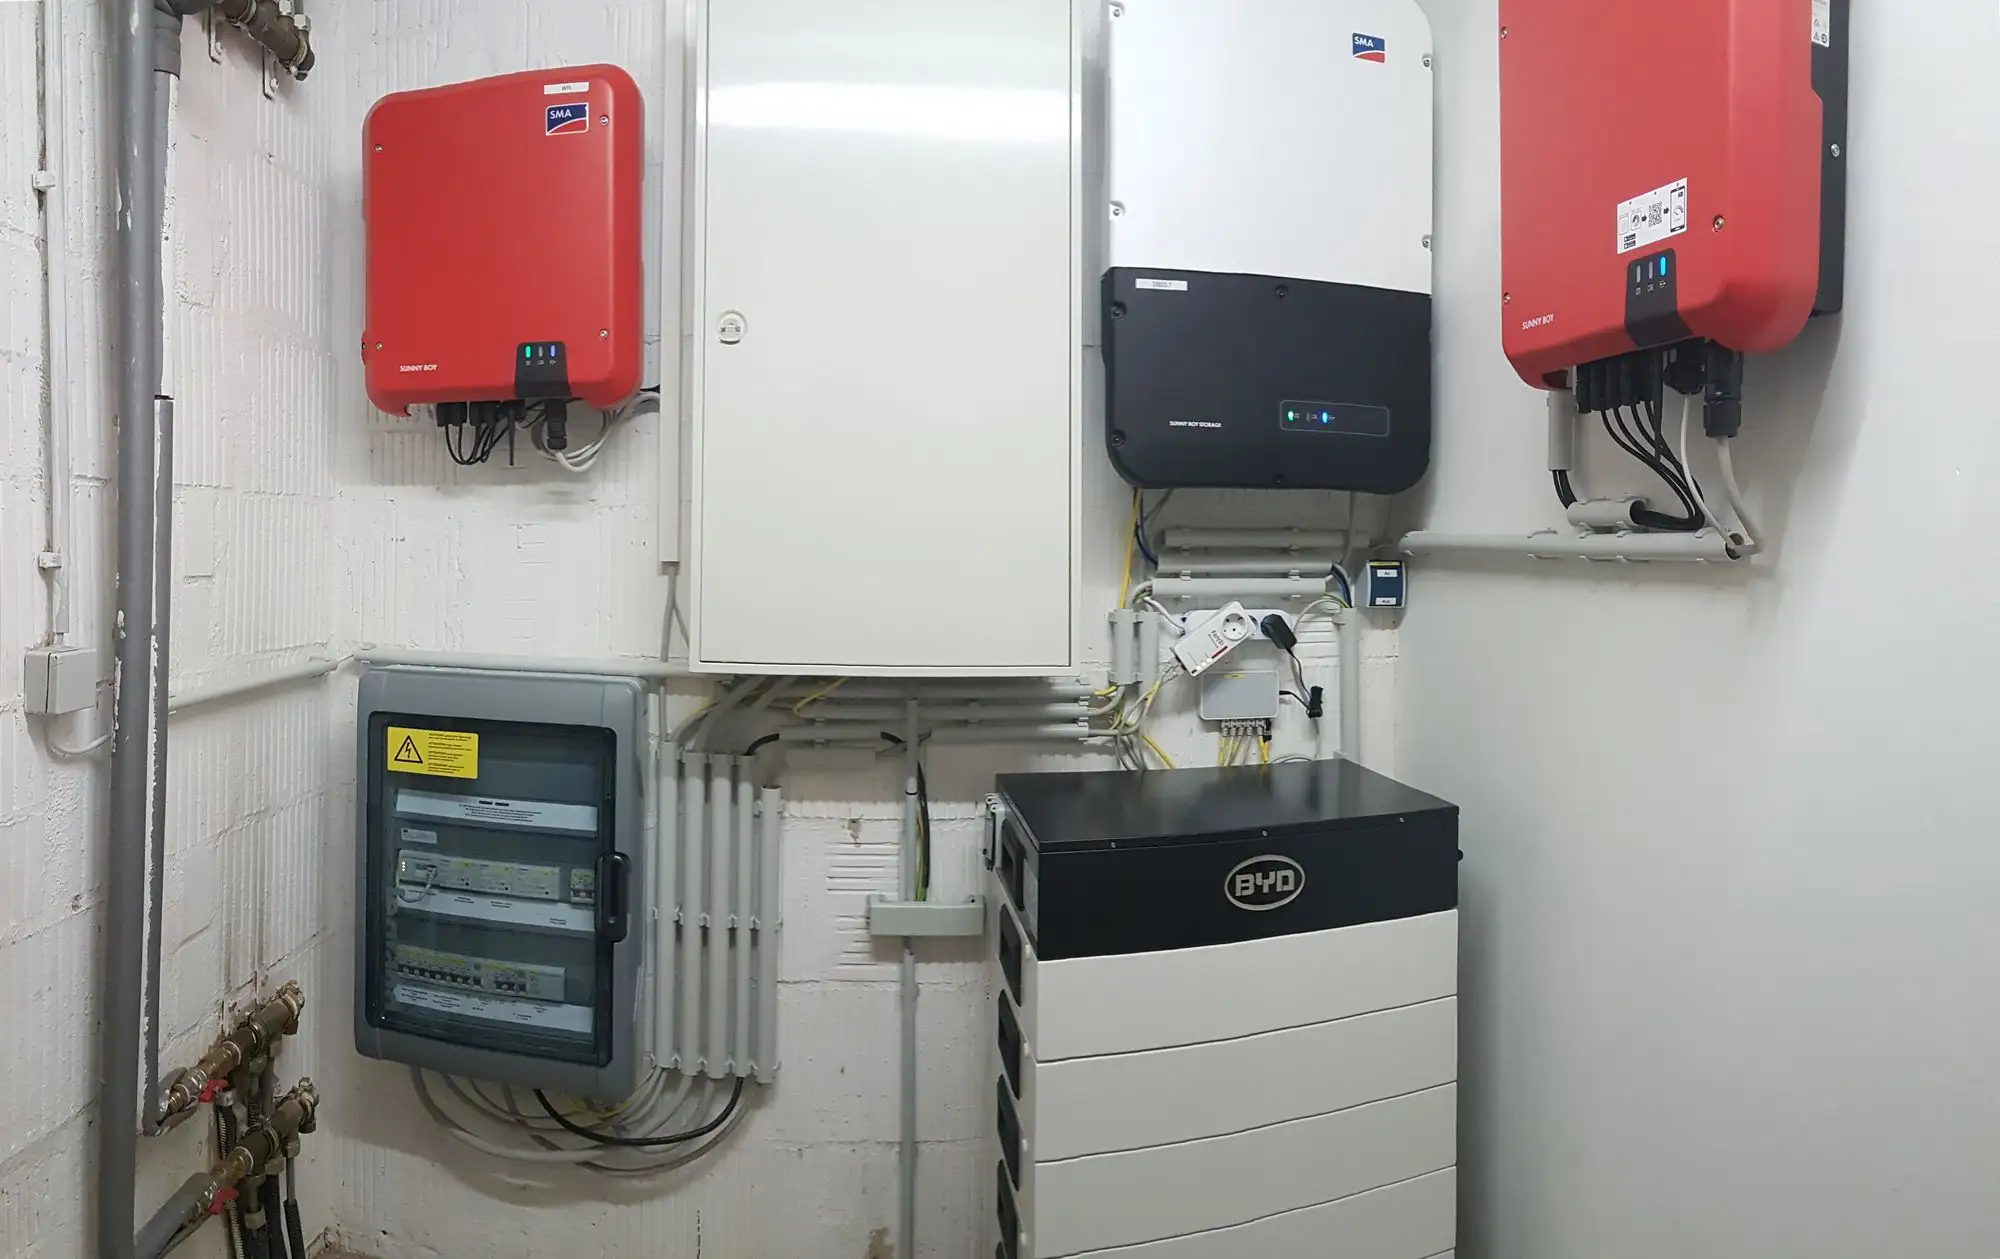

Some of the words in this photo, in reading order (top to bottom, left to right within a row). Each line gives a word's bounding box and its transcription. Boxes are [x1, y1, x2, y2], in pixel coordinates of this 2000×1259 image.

[1354, 36, 1374, 48] SMA
[550, 108, 573, 120] SMA
[1522, 317, 1542, 330] SUNNY
[1542, 313, 1554, 325] BOY
[1235, 869, 1296, 897] BYD
